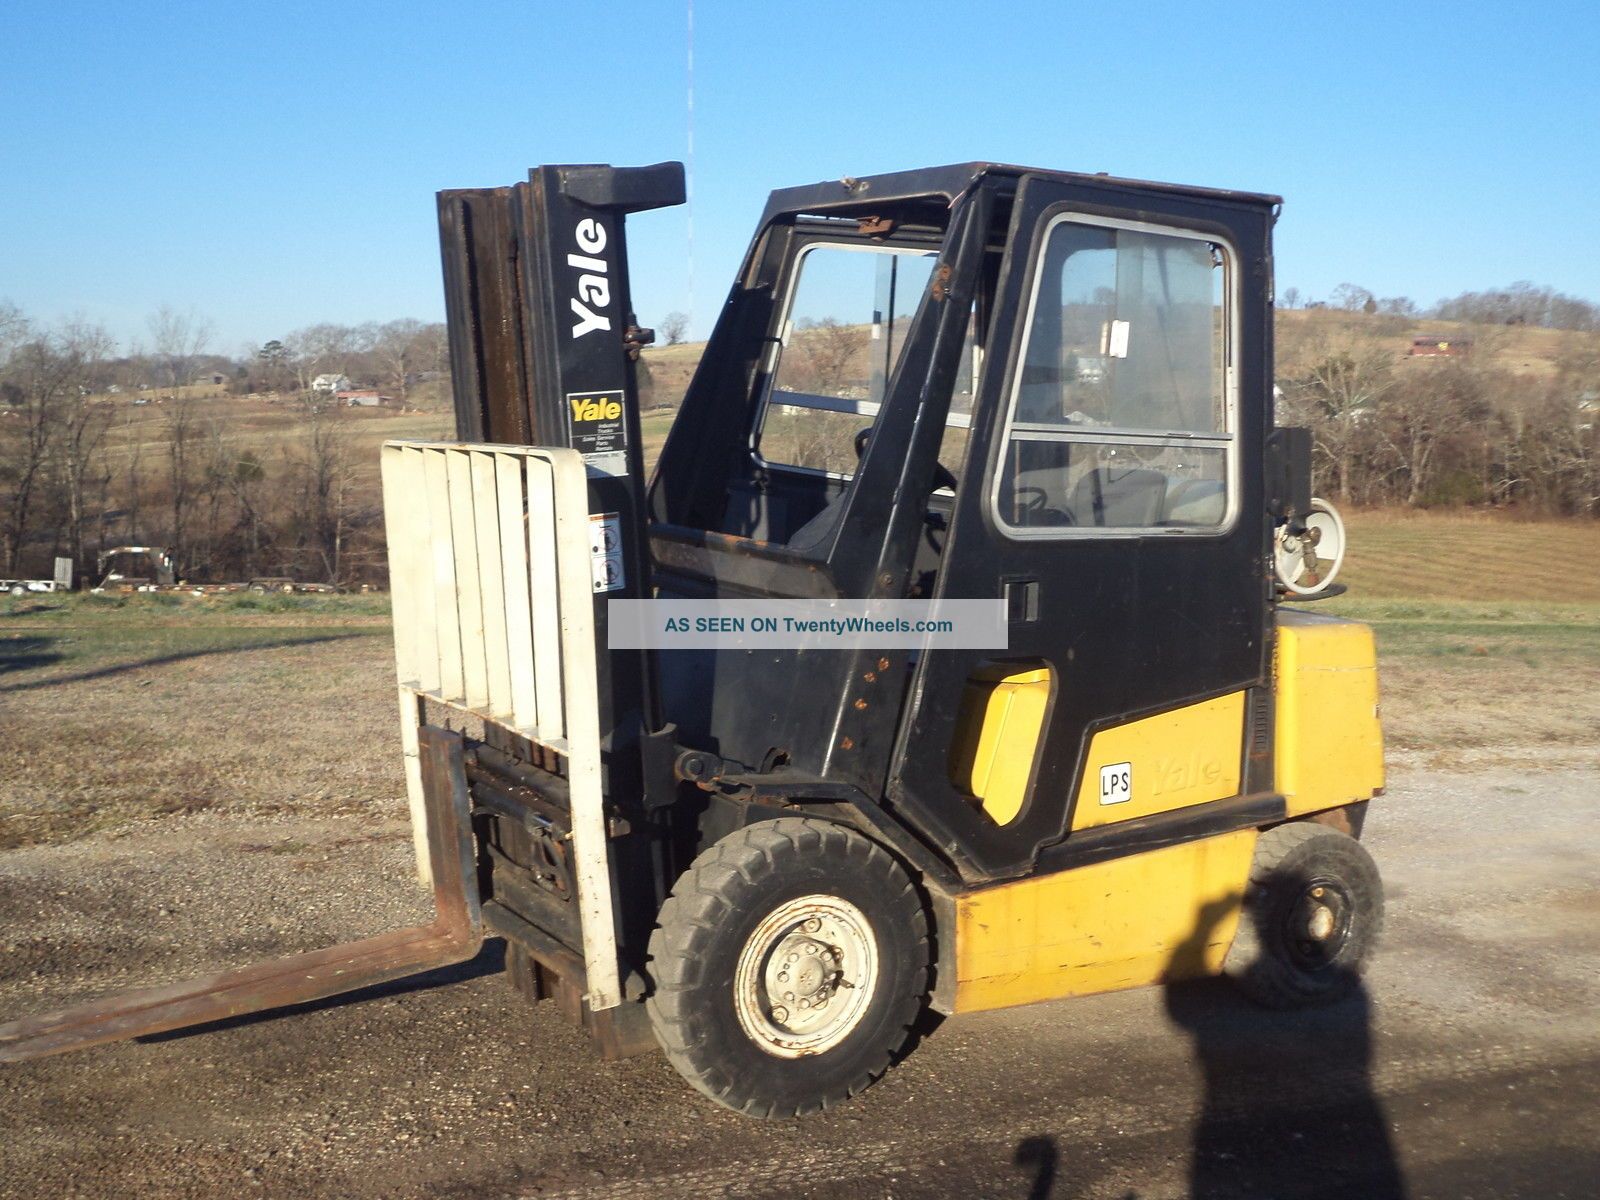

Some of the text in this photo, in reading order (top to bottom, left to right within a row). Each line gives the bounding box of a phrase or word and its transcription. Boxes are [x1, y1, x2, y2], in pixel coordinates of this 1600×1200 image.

[567, 218, 611, 339] Yale
[570, 397, 621, 422] Yale
[1102, 772, 1129, 796] LPS
[1151, 752, 1222, 796] Yale
